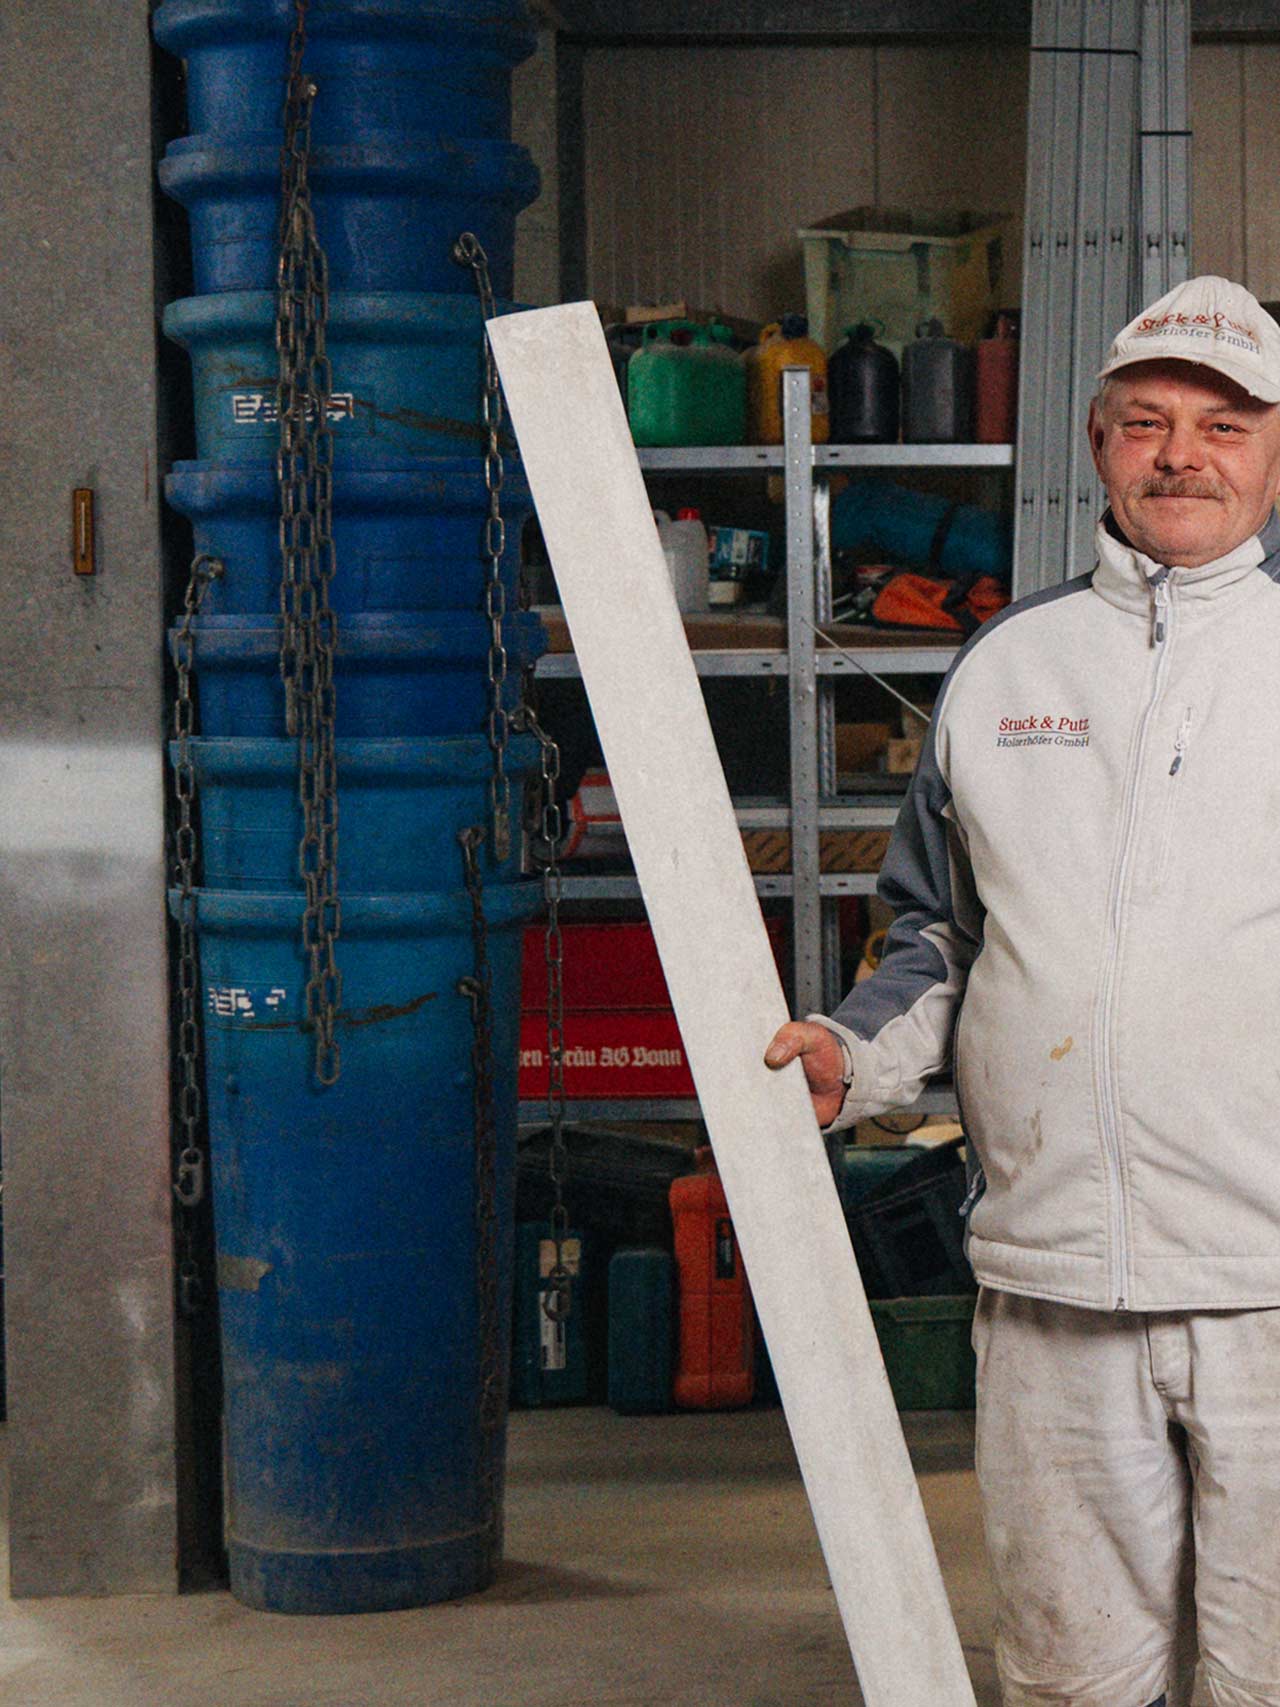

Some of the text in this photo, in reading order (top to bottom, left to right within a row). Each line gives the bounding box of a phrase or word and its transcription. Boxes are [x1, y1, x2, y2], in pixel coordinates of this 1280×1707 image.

[1214, 331, 1260, 355] GmbH
[998, 715, 1090, 732] Stuck & Putz
[1054, 736, 1090, 748] GmbH
